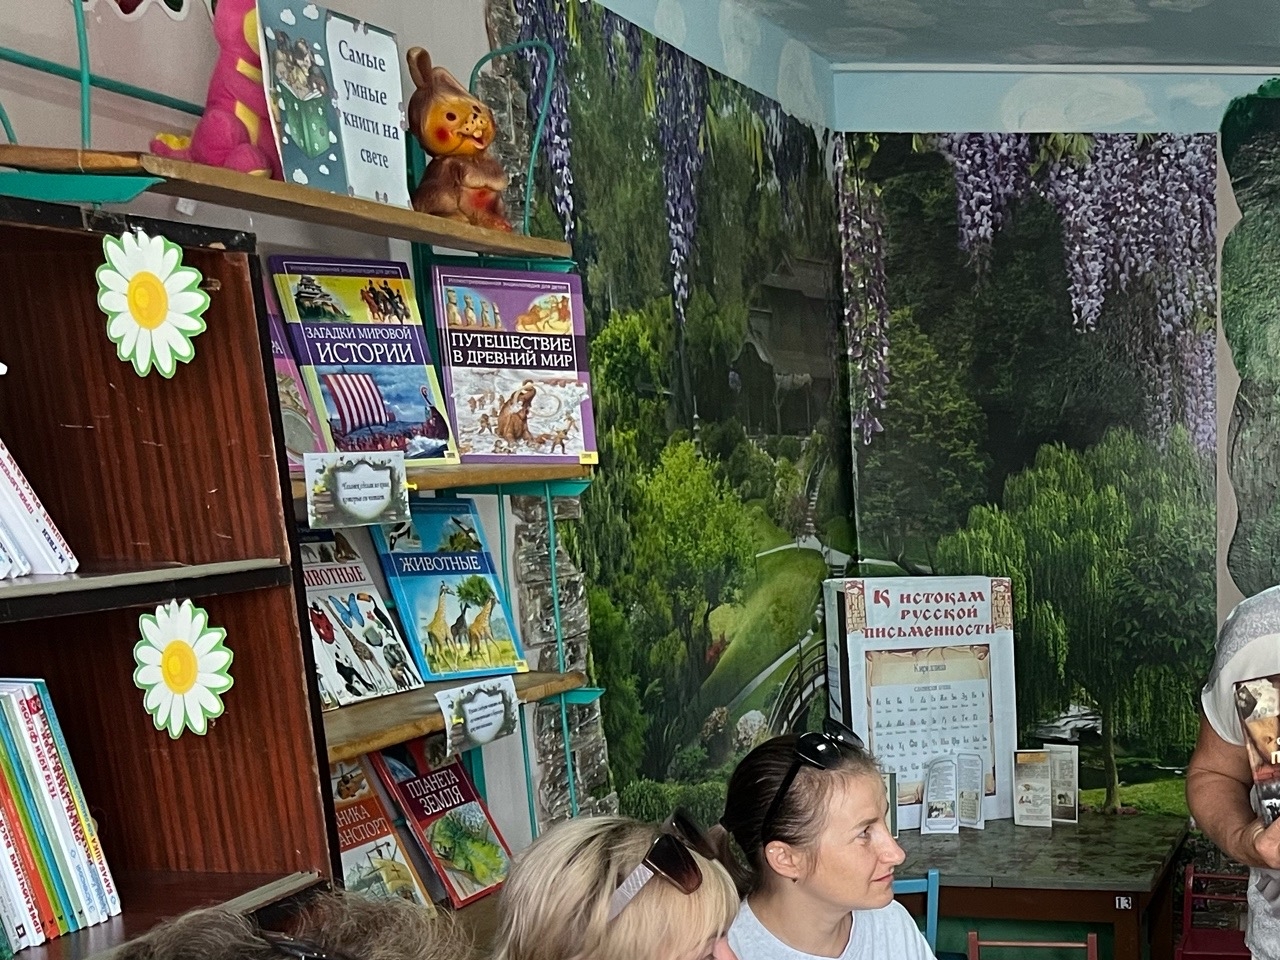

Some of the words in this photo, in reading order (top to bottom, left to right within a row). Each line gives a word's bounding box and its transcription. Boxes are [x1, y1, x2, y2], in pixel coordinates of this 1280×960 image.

[339, 40, 386, 72] Самые
[343, 79, 387, 105] умные
[343, 111, 380, 135] книги
[383, 123, 400, 140] на
[360, 148, 389, 169] свете
[305, 327, 356, 340] ЗАГАДКИ
[357, 326, 412, 340] МИРОВОЙ
[451, 332, 572, 351] ПУТЕШЕСТВИЕ
[316, 343, 416, 363] ИСТОРИИ
[452, 350, 464, 363] В
[466, 350, 537, 366] ДРЕВНИЙ
[541, 353, 573, 367] МИР
[41, 528, 58, 553] ТВЕН
[402, 556, 482, 572] ЖИВОТНЫЕ
[304, 565, 366, 587] ИВОТНЫЕ
[873, 589, 891, 608] К
[406, 768, 460, 799] ПЛАНЕТА
[419, 785, 465, 817] ЗЕМЛЯ
[336, 805, 371, 828] НИКА
[340, 817, 389, 848] АНСПОРТ
[91, 837, 114, 896] БАРАБАШКА
[9, 854, 42, 935] ПРИКЛЮЧЕНИЯ
[1117, 897, 1131, 909] 13
